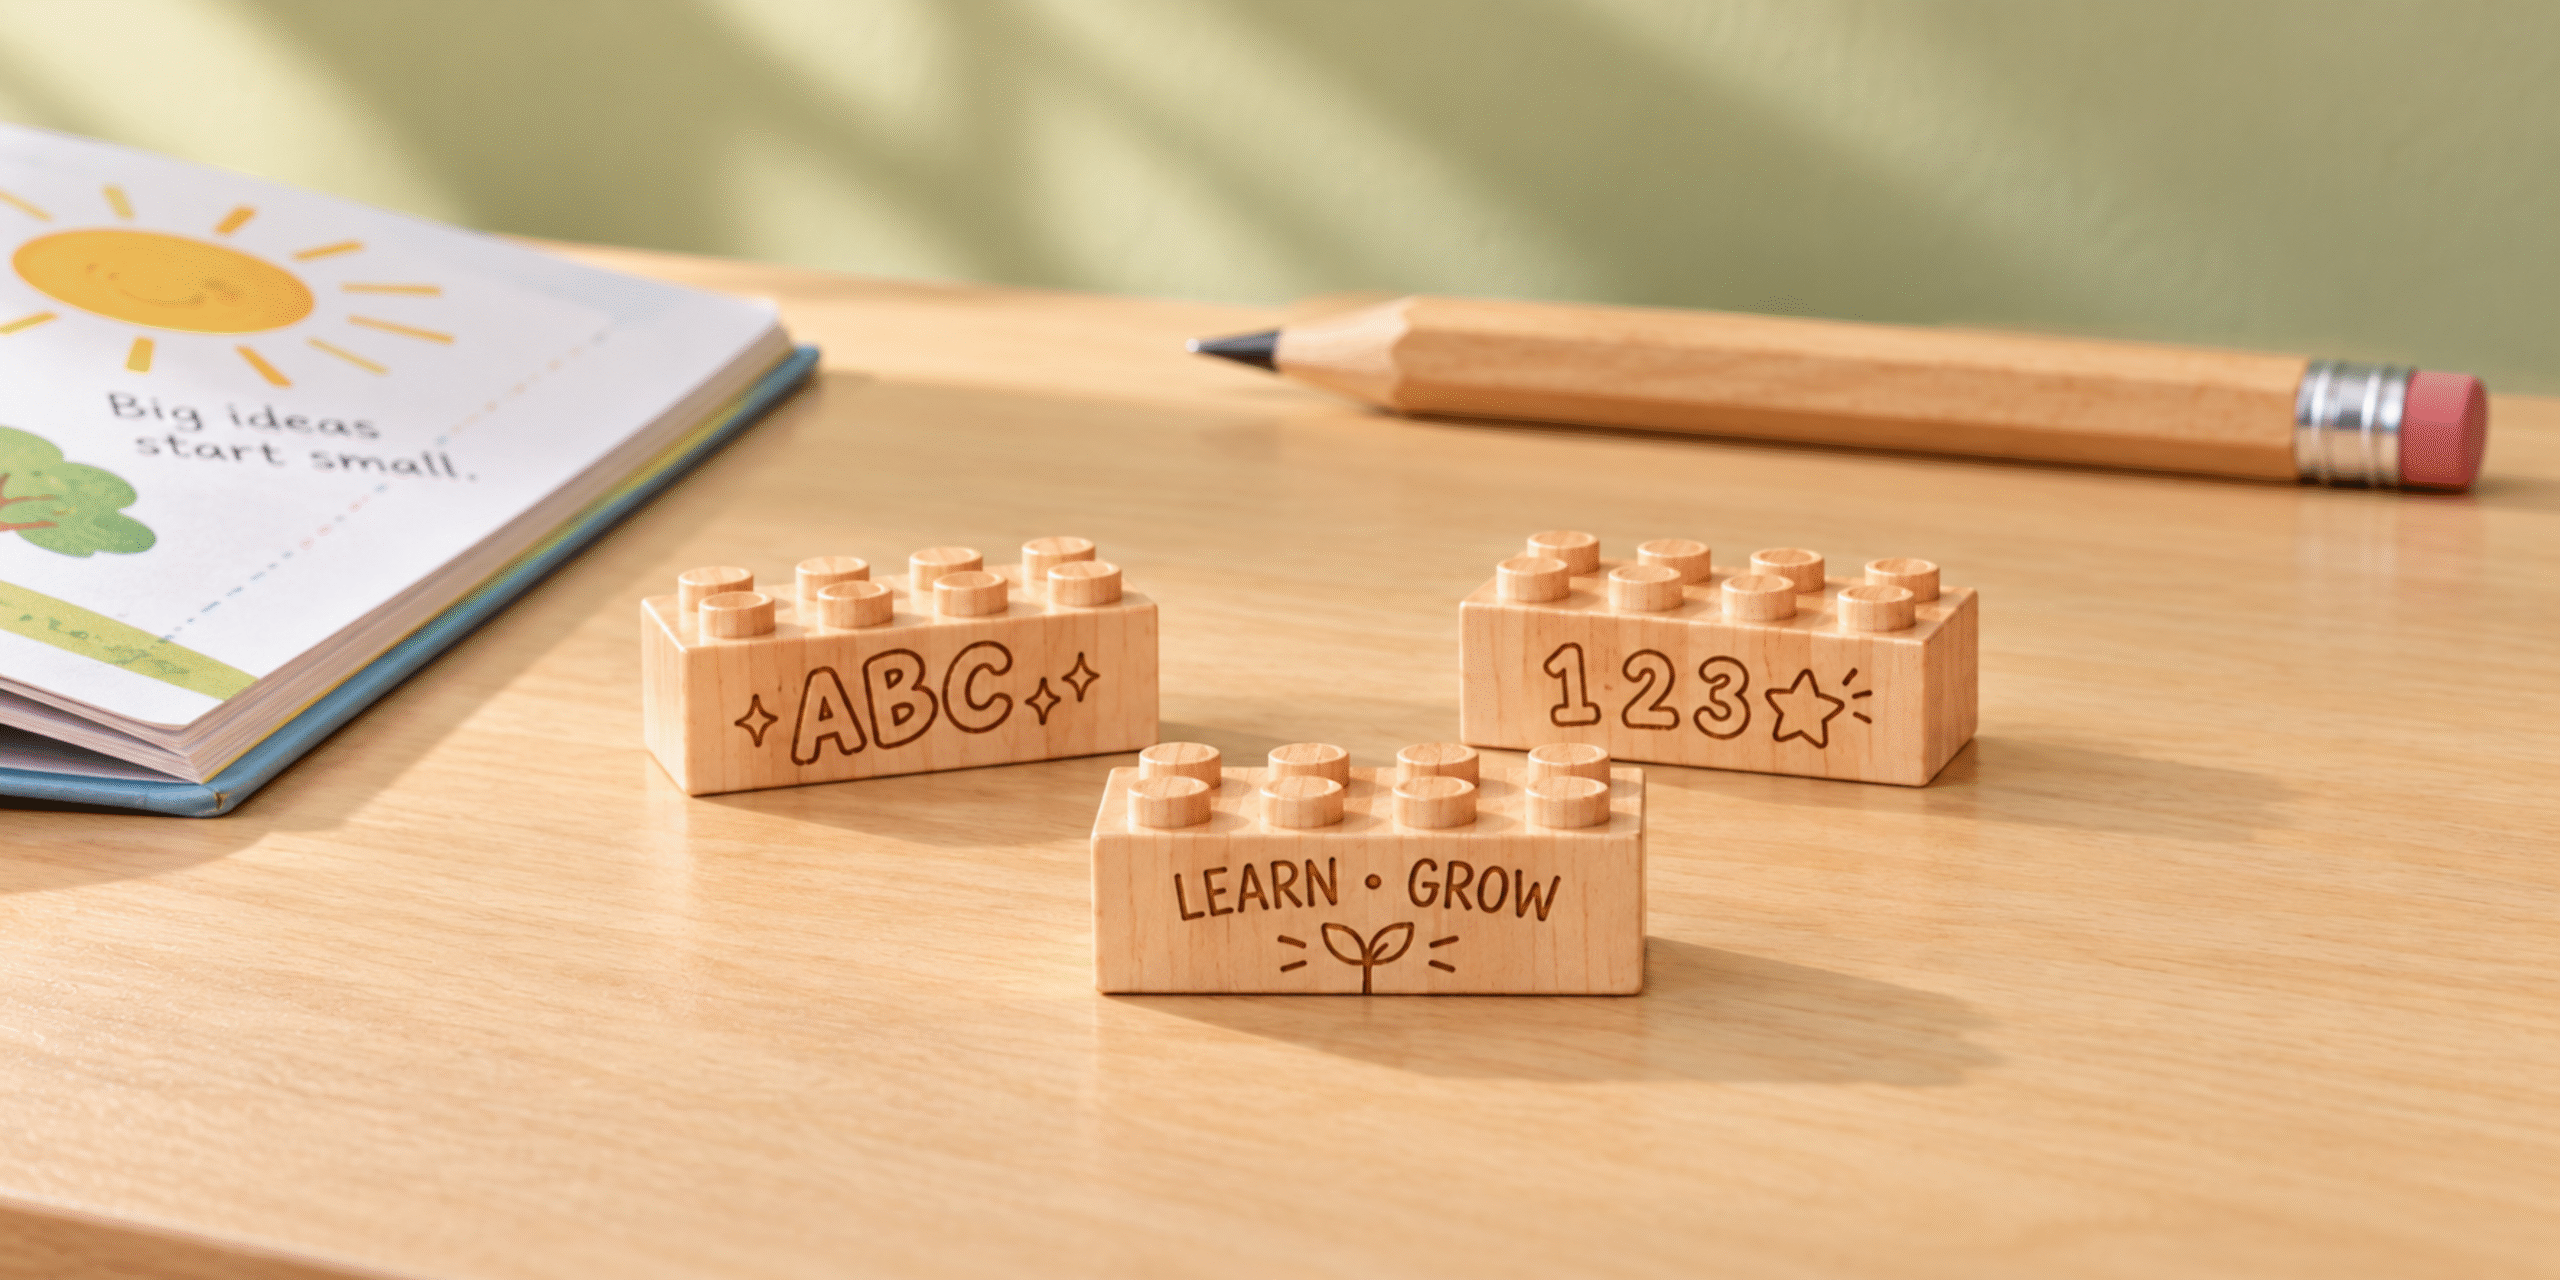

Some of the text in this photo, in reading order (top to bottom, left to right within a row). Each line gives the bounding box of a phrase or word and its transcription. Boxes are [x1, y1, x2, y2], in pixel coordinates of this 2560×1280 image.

[107, 391, 381, 441] Big ideas
[134, 432, 480, 483] start small.
[790, 640, 1014, 766] ABC
[1173, 856, 1338, 921] LEARN
[1408, 857, 1561, 922] GROW
